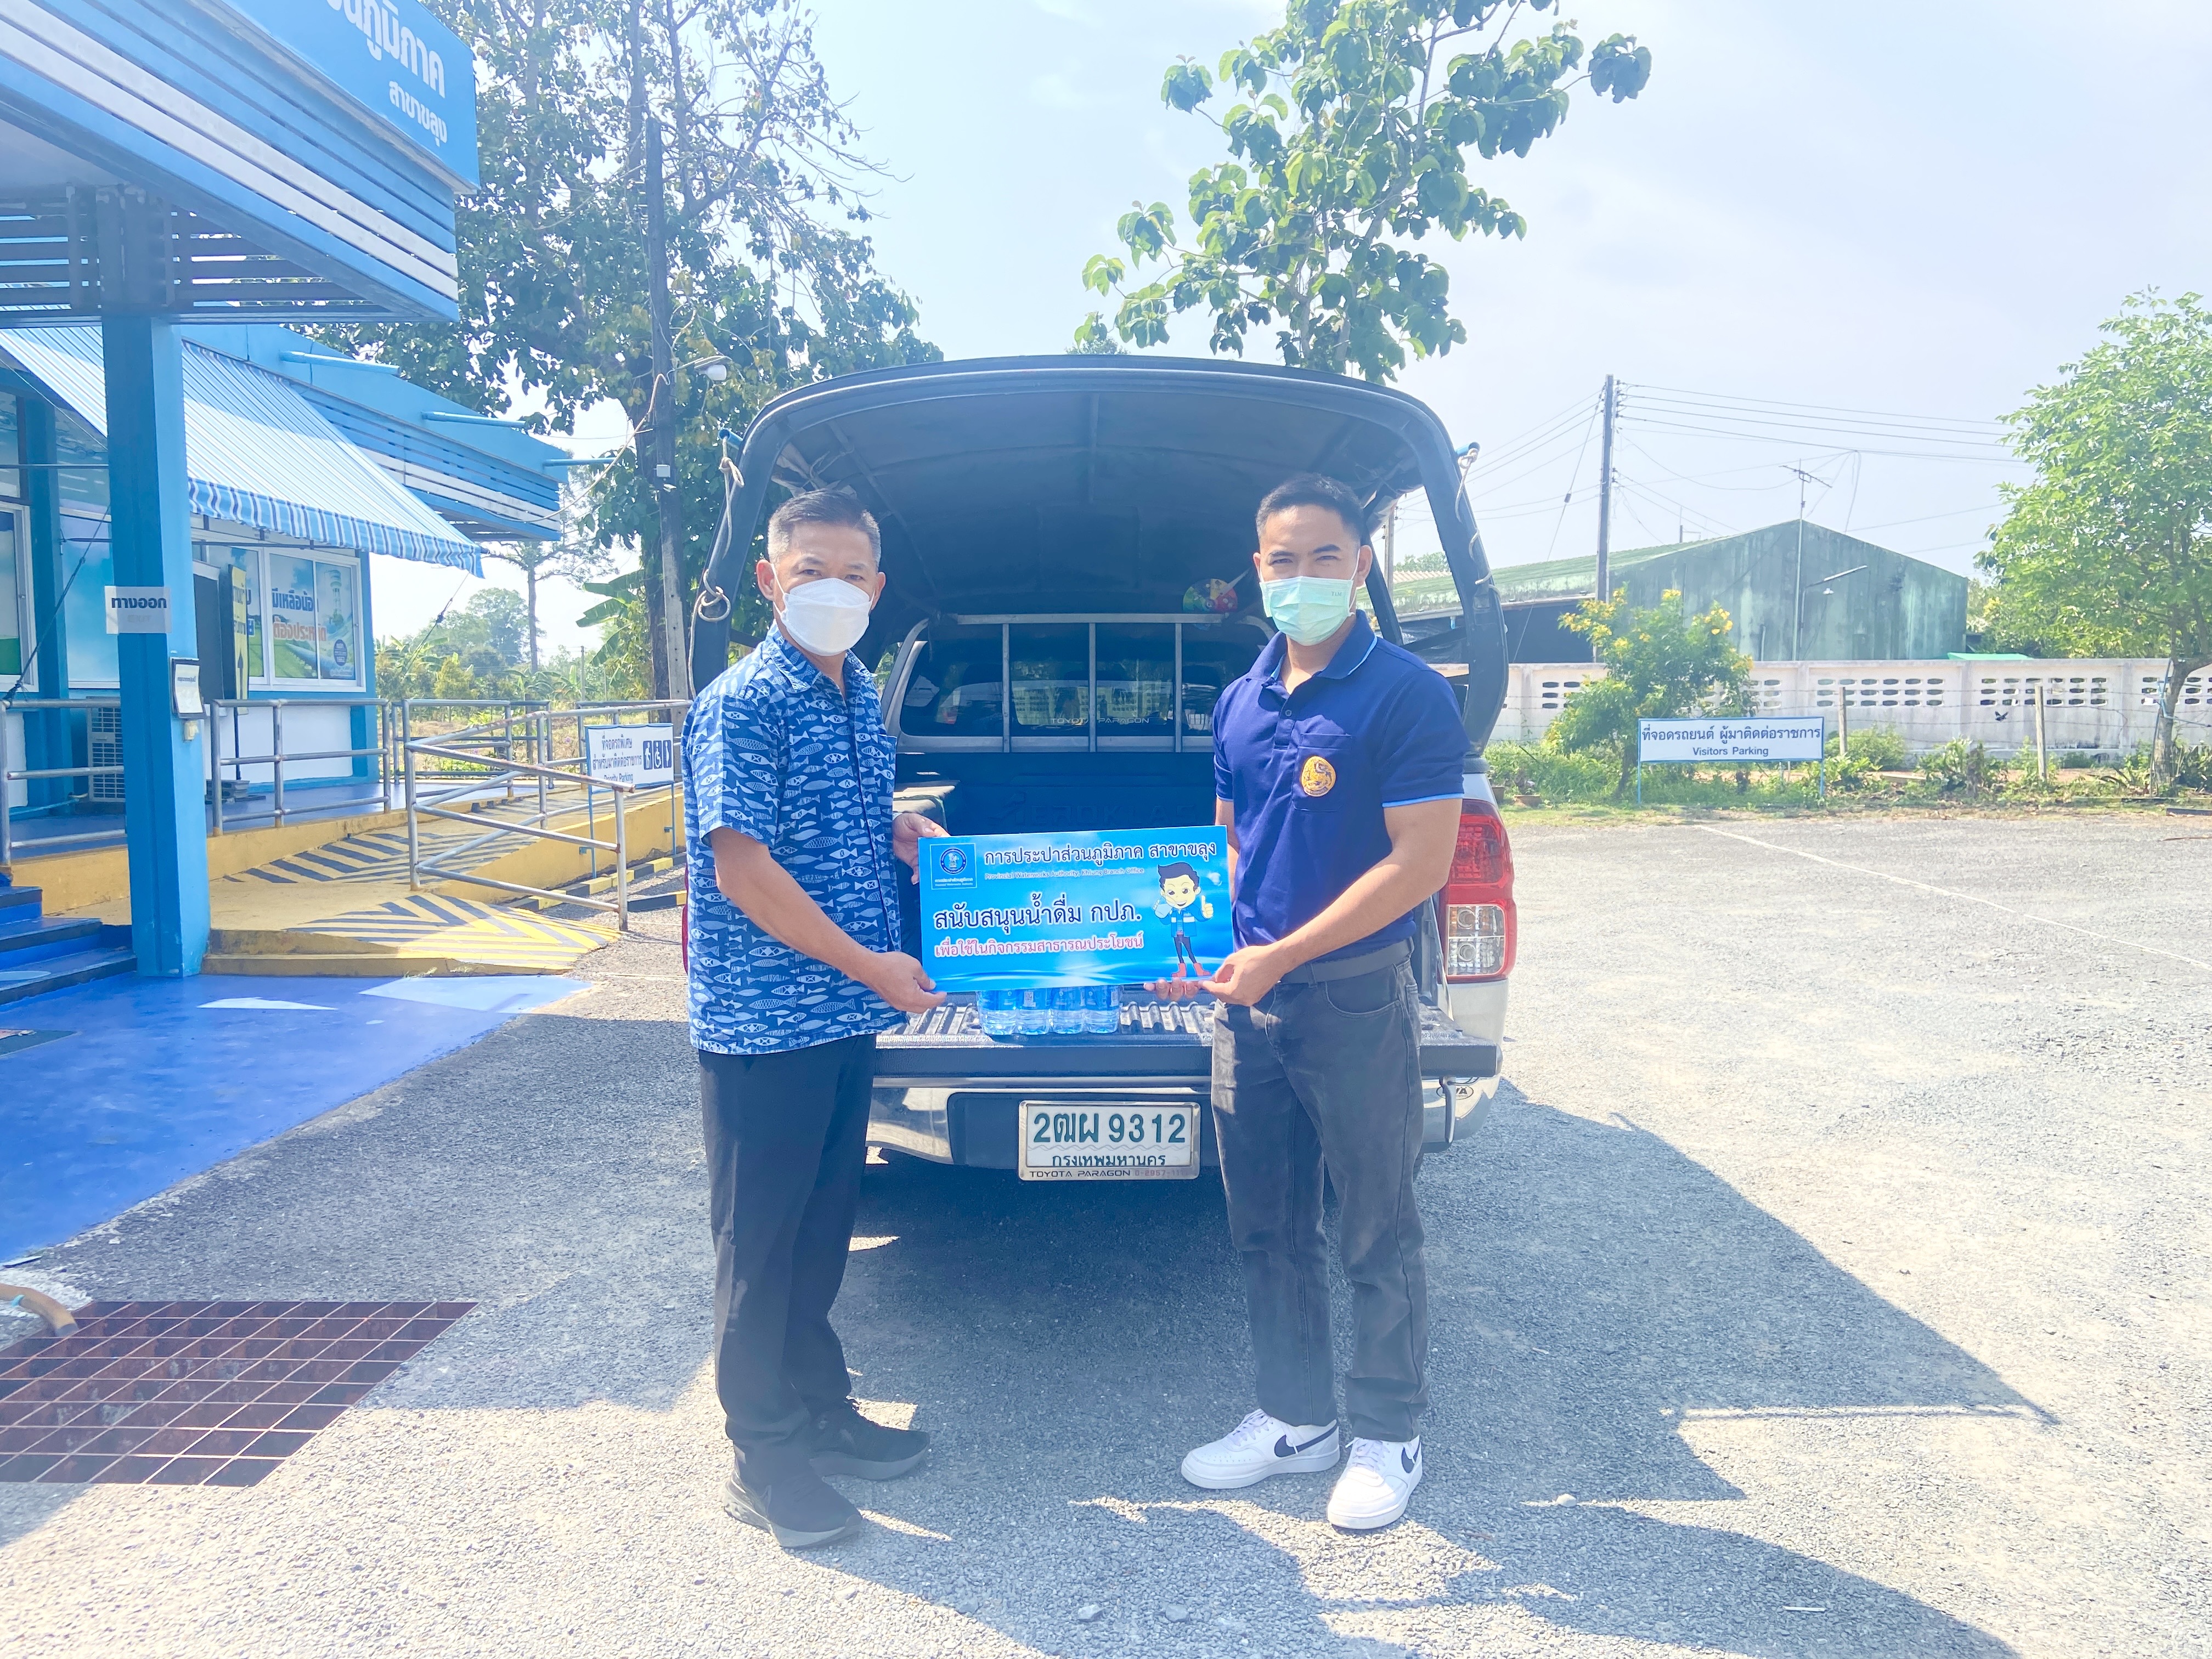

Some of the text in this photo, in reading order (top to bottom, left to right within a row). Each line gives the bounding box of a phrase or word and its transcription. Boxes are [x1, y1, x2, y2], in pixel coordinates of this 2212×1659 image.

[389, 81, 447, 147] สาขาขลุง
[111, 597, 167, 608] ทางออก
[272, 588, 319, 612] มีเหลือน้อ
[274, 616, 327, 641] ต้องประหัด
[1642, 724, 1821, 744] ที่จอดรถยนต์ ผู้มาติดต่อราชการ
[1693, 747, 1769, 757] Visitors Parking
[619, 772, 633, 783] Parking
[985, 843, 1143, 866] การประปาส่วนภูมิภาค
[1149, 843, 1216, 861] สาขาขลุง
[934, 893, 1142, 934] สนับสนุนน้ำดื่ม กปภ.
[935, 932, 1143, 957] เพื่อใช้ในกิจกรรมสาธารณประโยชน์
[1109, 1113, 1186, 1143] 9312
[1052, 1154, 1166, 1166] กรงเทพมหานคร
